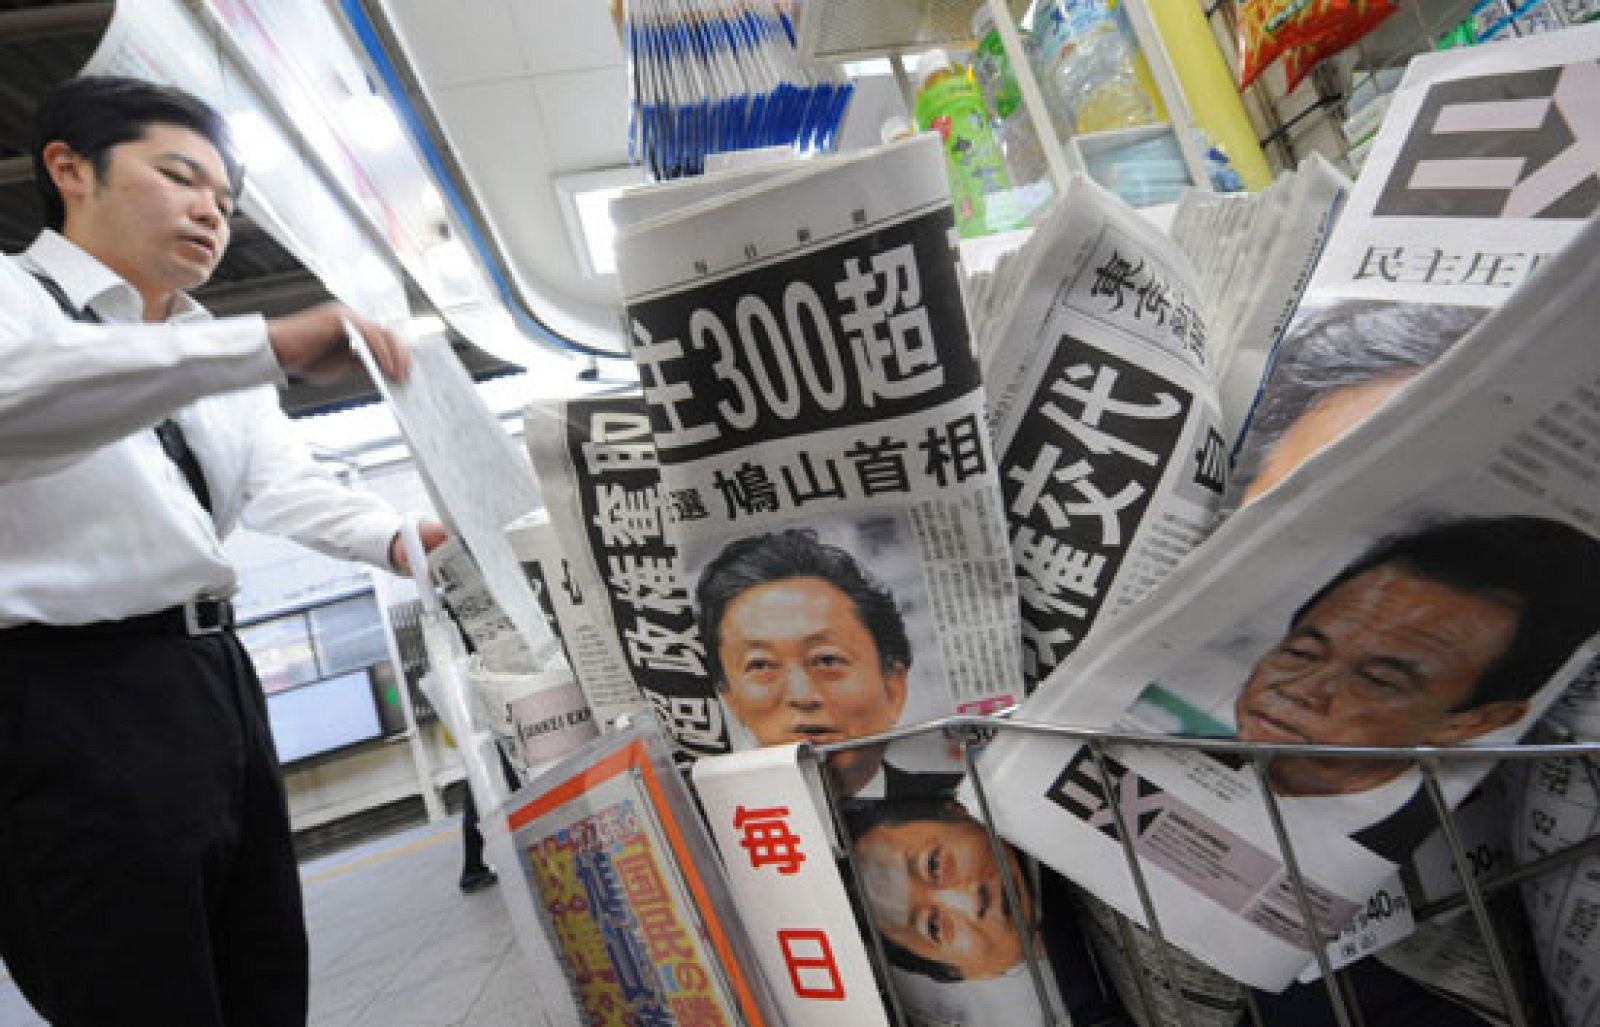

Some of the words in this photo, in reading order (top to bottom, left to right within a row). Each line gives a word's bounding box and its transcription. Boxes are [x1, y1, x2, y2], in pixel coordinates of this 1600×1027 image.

[713, 412, 986, 521] 鳩山首相
[733, 804, 845, 1001] 毎日
